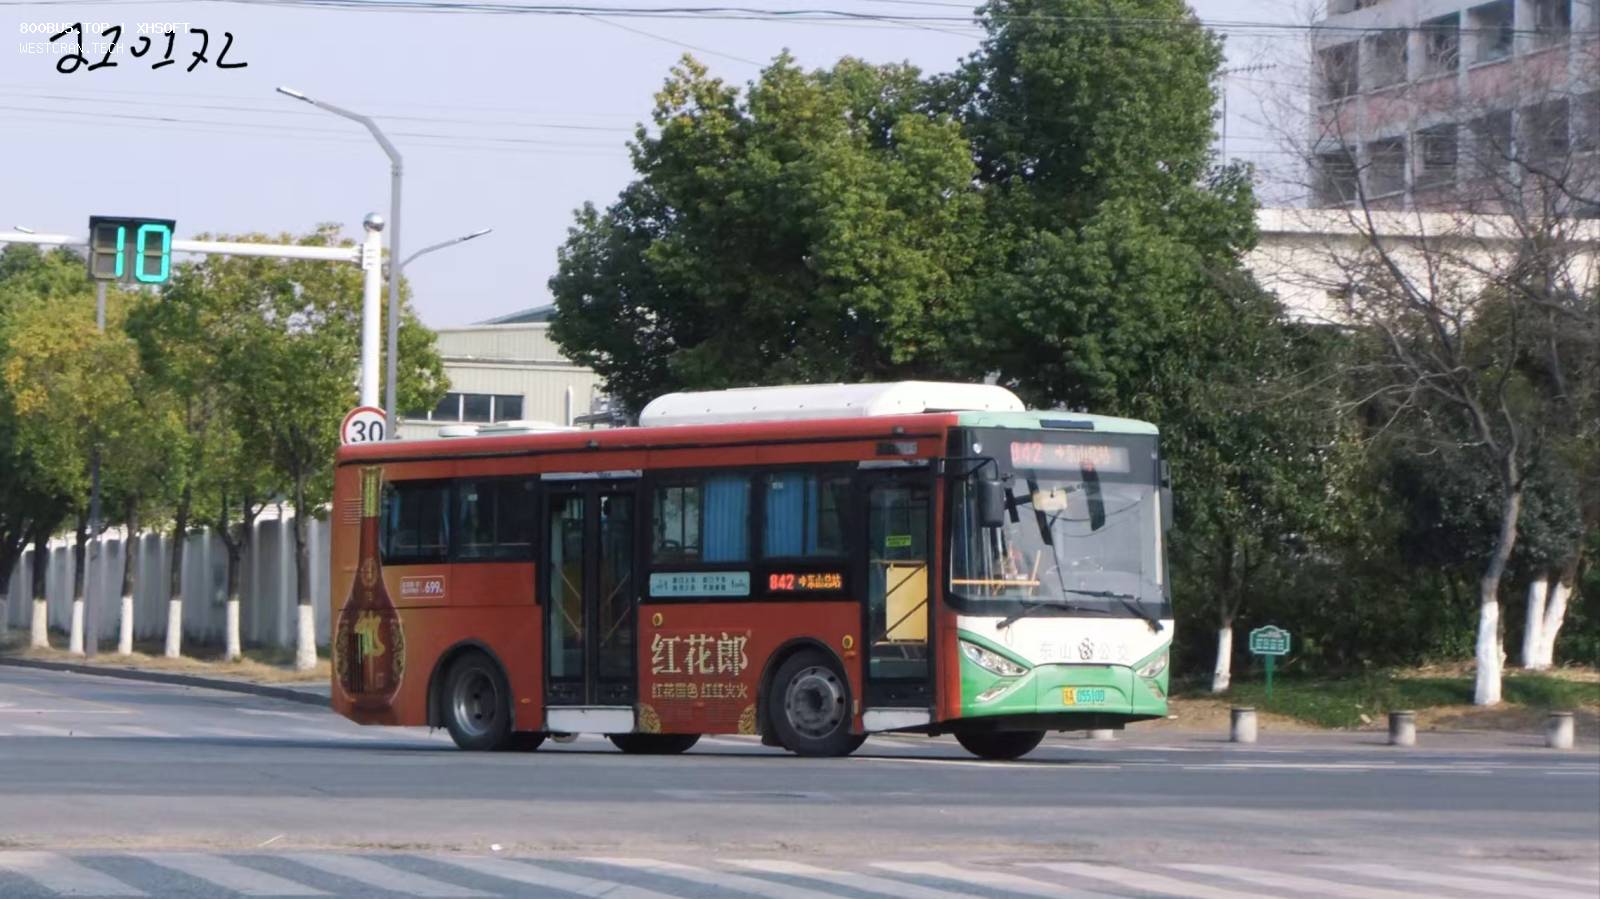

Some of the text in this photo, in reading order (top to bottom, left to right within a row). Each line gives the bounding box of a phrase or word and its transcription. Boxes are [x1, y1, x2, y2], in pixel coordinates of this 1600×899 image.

[115, 224, 171, 282] 10
[351, 420, 383, 442] 30
[1010, 441, 1041, 464] 842
[769, 573, 795, 591] 842
[651, 631, 748, 677] 红花郎
